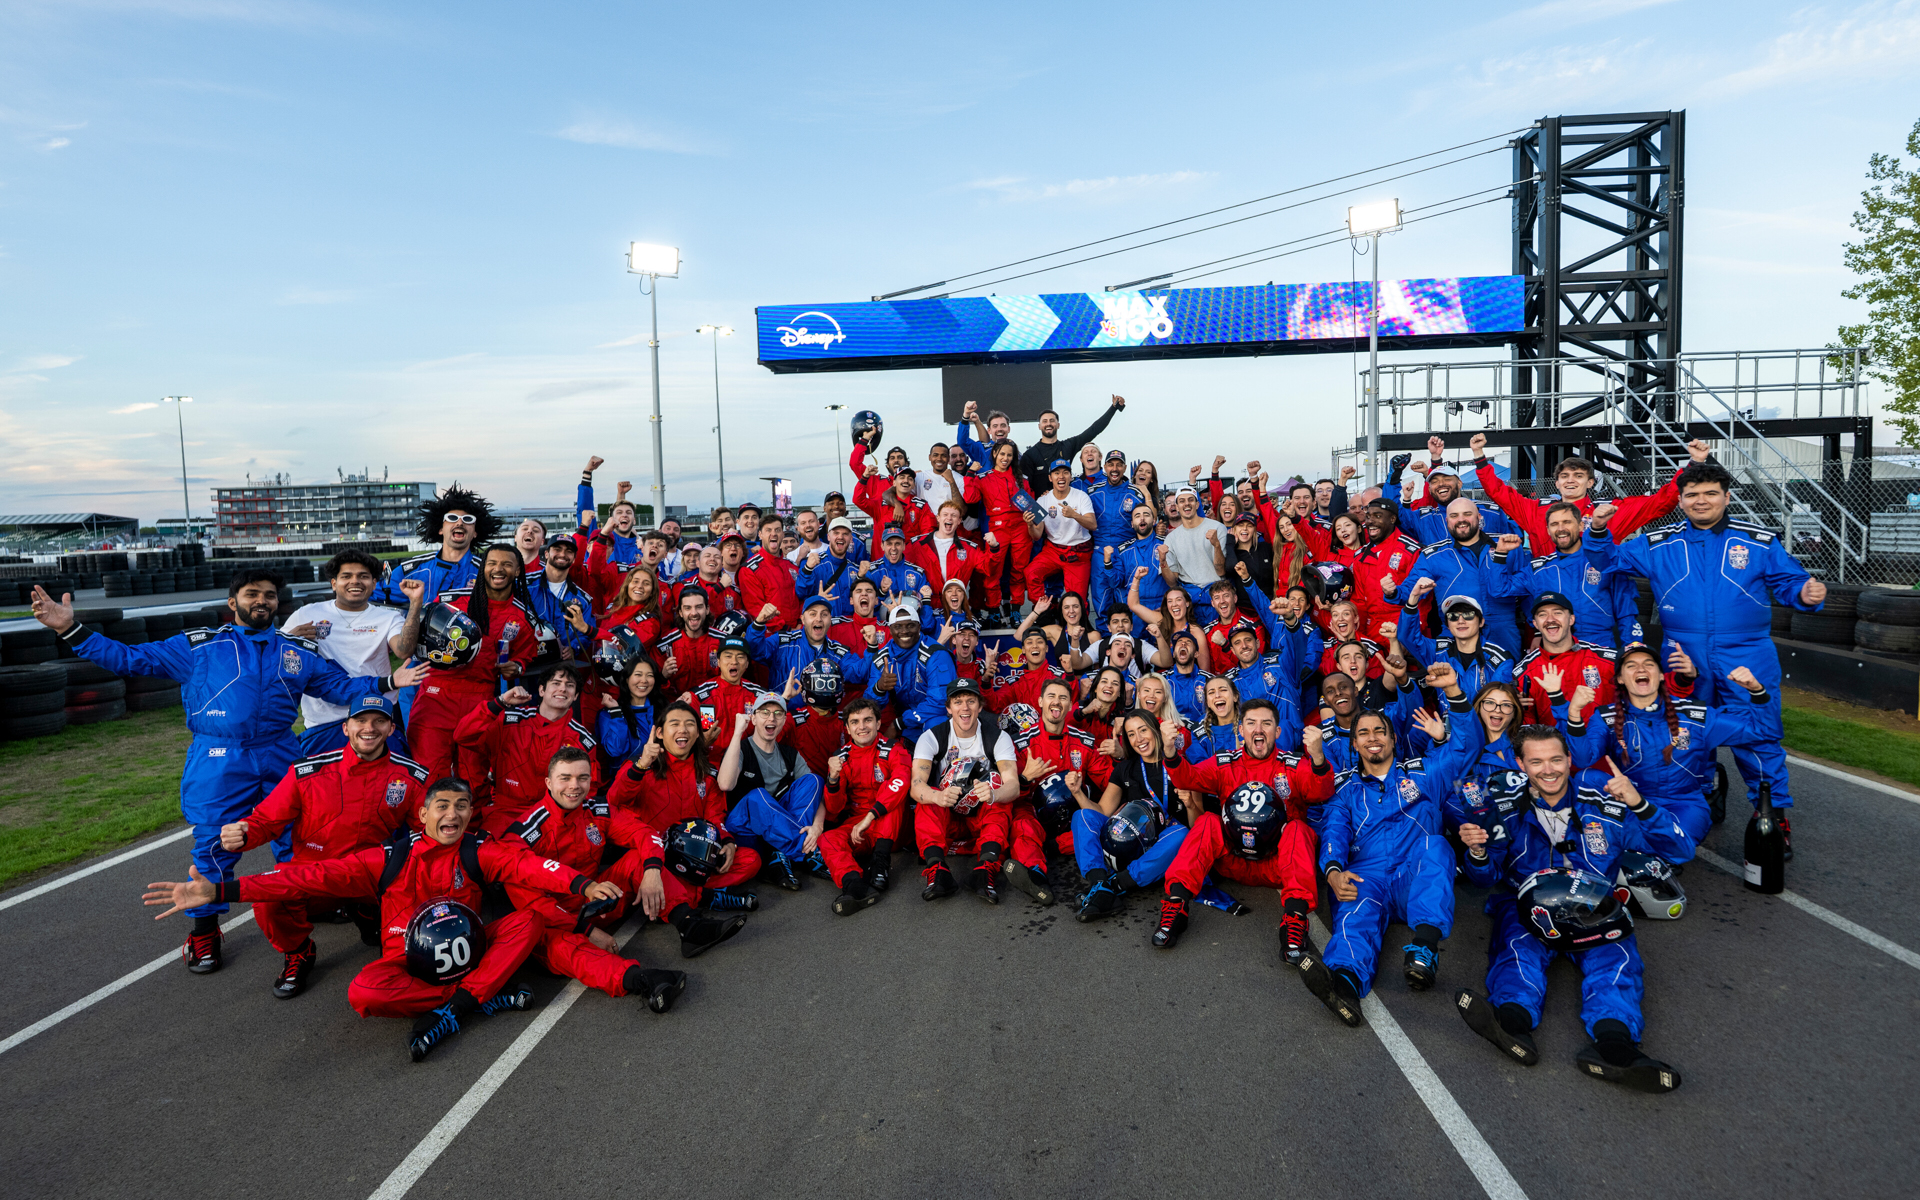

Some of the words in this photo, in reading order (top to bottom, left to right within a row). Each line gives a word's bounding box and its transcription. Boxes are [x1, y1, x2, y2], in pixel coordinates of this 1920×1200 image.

[1104, 296, 1169, 319] MAX
[1119, 317, 1173, 340] 100
[776, 326, 847, 350] Disney+
[719, 617, 738, 634] 15
[888, 778, 904, 792] 60
[1235, 789, 1266, 814] 39
[1604, 807, 1622, 815] OMP
[1493, 825, 1506, 840] 2
[1569, 878, 1581, 895] GIVES
[434, 936, 471, 974] 50
[1461, 994, 1471, 1008] OMP
